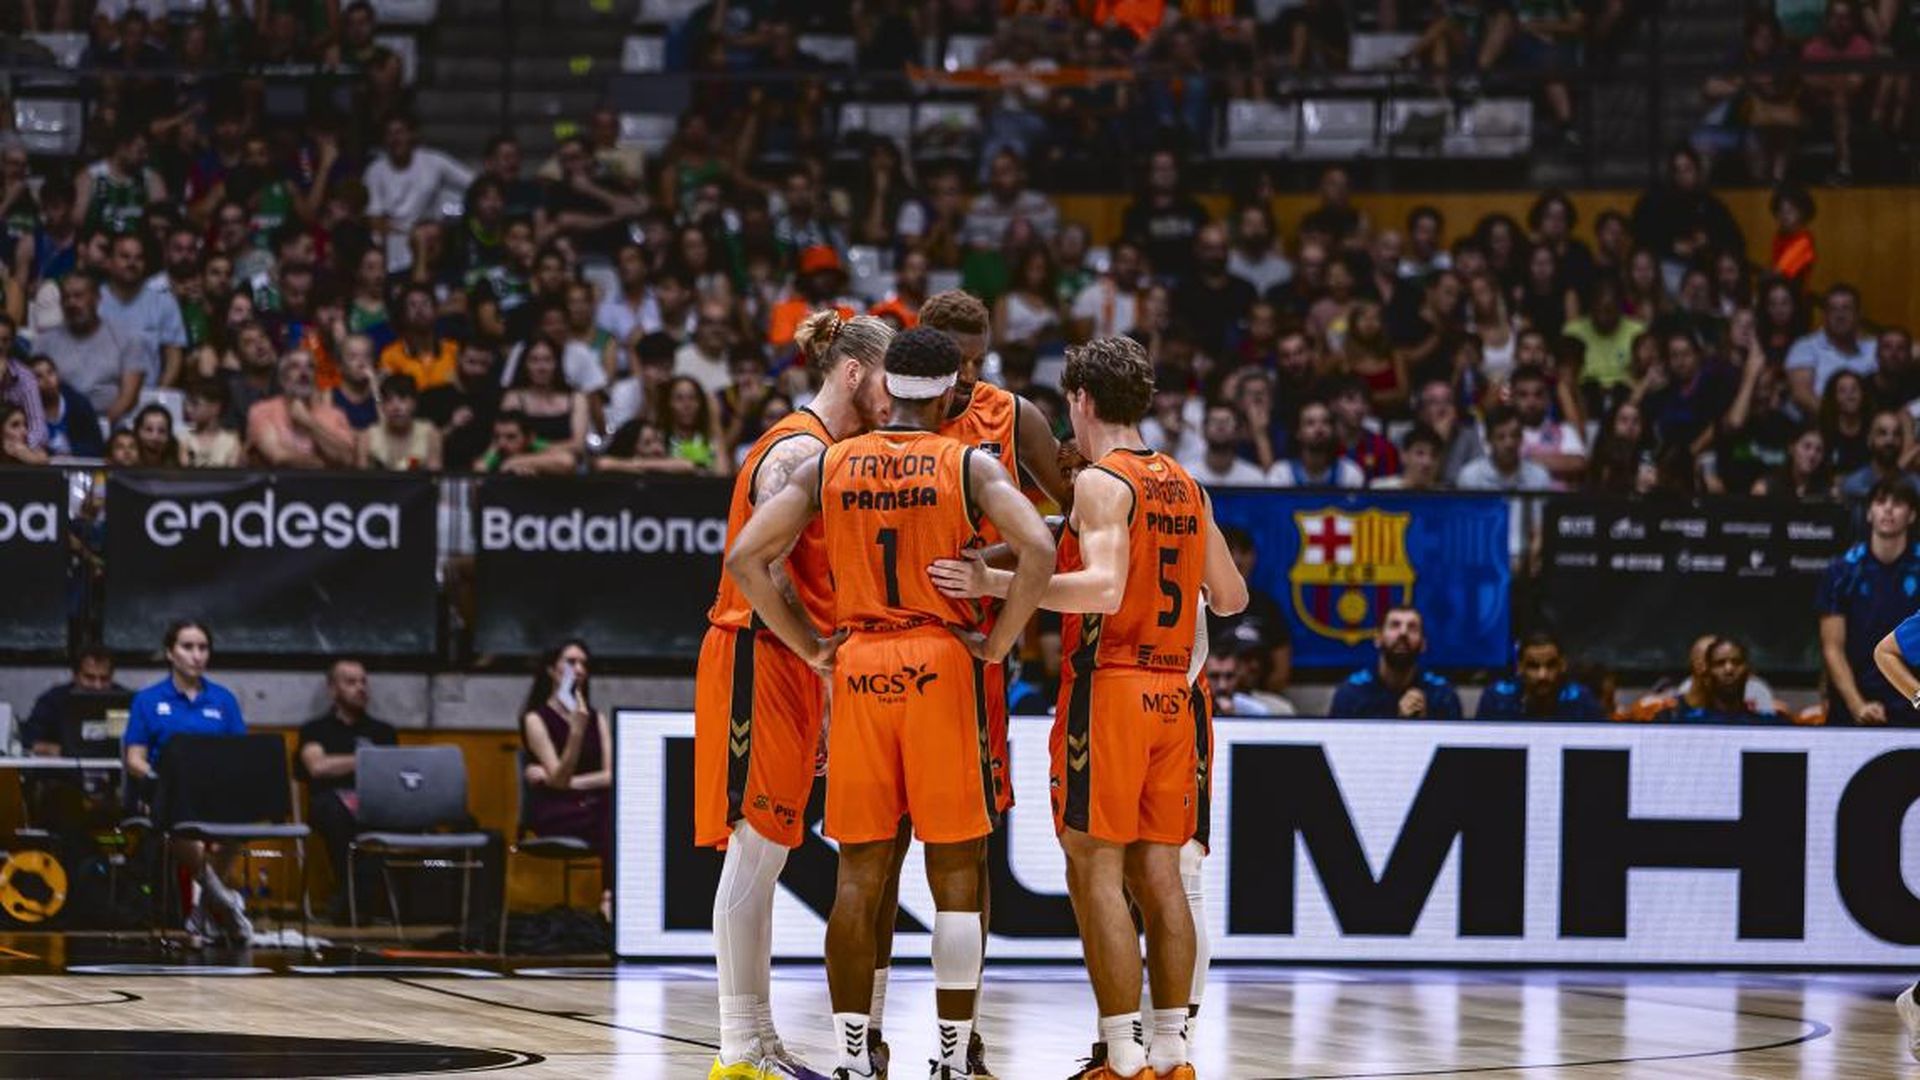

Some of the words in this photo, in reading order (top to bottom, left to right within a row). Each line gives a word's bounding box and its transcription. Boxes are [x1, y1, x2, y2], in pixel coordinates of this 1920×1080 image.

[848, 453, 936, 480] TAYLOR
[145, 489, 400, 549] endesa
[841, 486, 938, 512] PAMESA
[482, 507, 728, 553] Badalona
[875, 527, 901, 609] 1
[1157, 547, 1184, 629] 5
[847, 673, 906, 695] MGS
